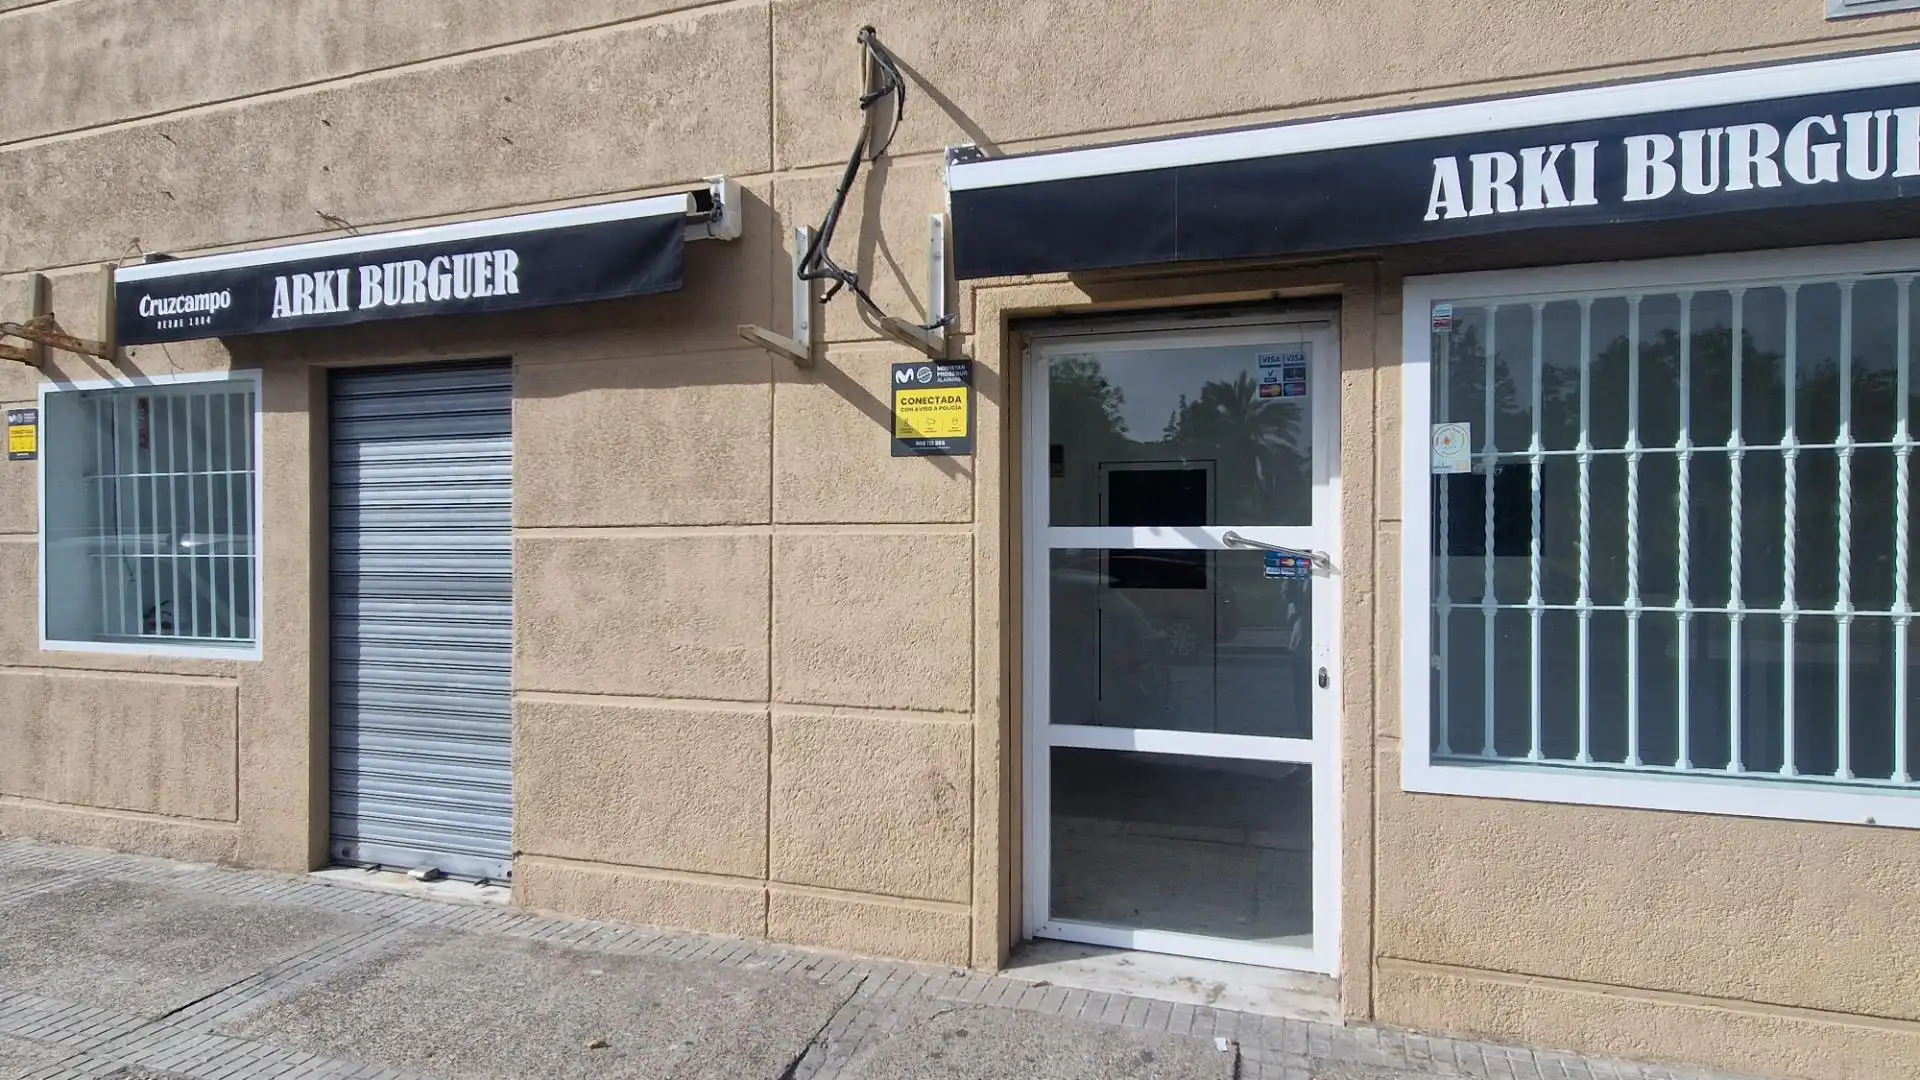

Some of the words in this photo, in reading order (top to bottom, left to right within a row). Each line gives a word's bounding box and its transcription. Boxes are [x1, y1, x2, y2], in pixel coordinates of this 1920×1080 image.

[1423, 140, 1600, 222] ARKI
[139, 290, 231, 317] Cruzcampo
[271, 268, 350, 319] ARKI
[358, 248, 520, 309] BURGUER
[900, 395, 962, 405] CONECTADA
